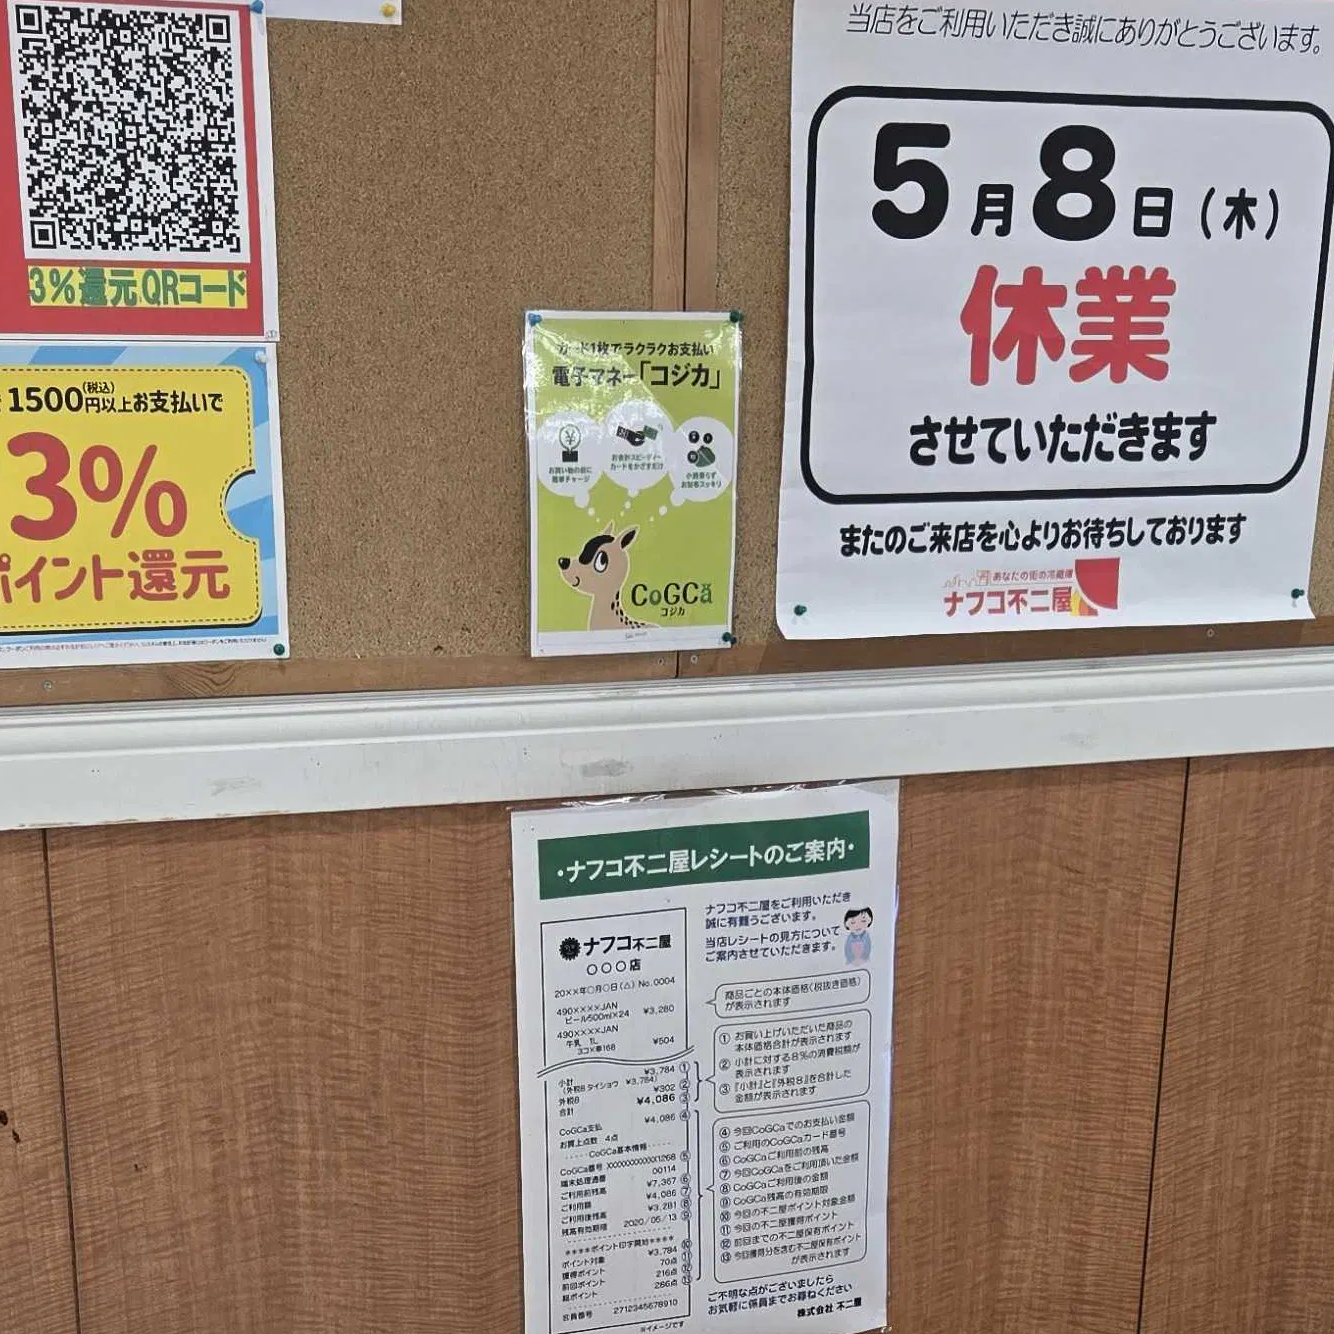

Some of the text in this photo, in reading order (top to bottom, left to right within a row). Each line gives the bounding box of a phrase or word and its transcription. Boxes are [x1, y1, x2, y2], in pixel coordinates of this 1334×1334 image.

[846, 4, 1323, 55] 当店をご利用いただき誠にありがとうございます。
[960, 264, 1177, 386] 休業
[10, 387, 223, 414] 1500円以上お支払いで
[908, 409, 1218, 467] させていただきます
[8, 432, 188, 540] 3%
[839, 511, 1248, 557] またのご来店を心よりお待ちしております
[660, 606, 686, 618] コジカ
[943, 586, 1073, 618] ナフコ不二屋
[706, 926, 840, 948] 当店レシートの見方について
